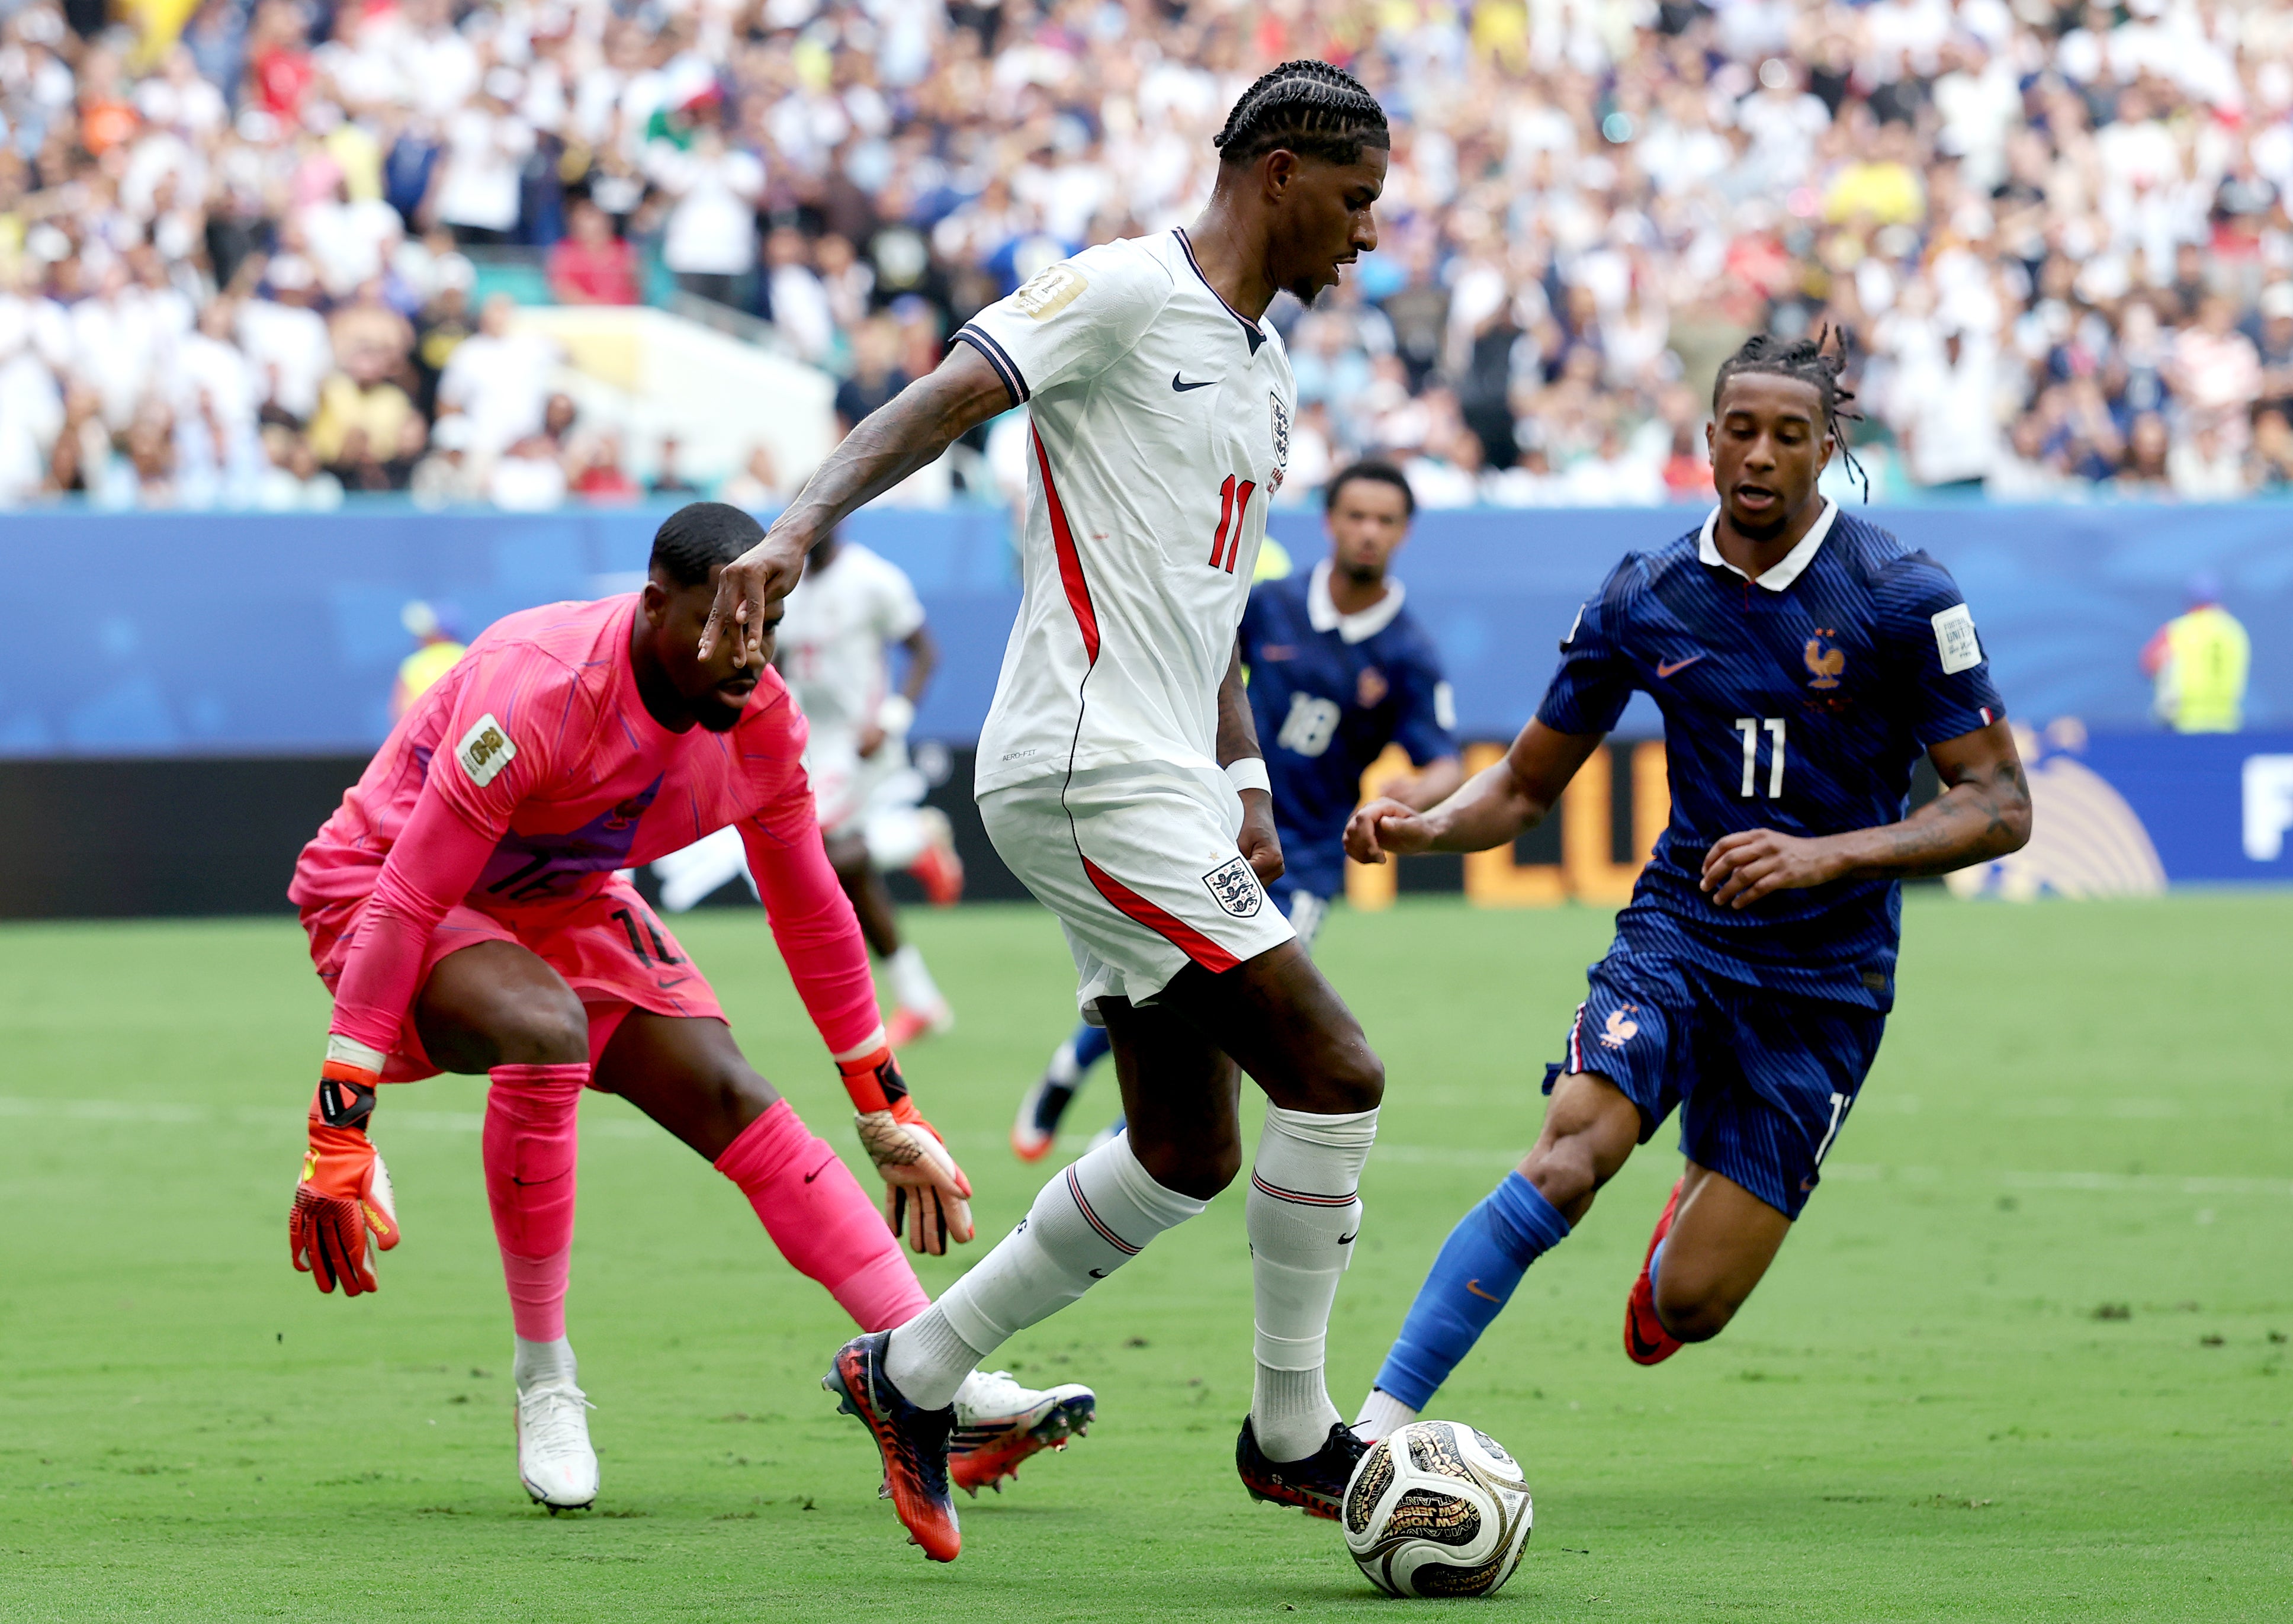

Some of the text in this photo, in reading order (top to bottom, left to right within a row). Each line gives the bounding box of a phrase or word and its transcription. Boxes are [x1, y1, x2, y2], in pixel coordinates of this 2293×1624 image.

[1209, 474, 1257, 575] 11
[1003, 749, 1038, 762] AERO-FIT
[1277, 691, 1341, 758] 18
[1735, 717, 1786, 798] 11
[1815, 1092, 1851, 1166] 1
[1362, 1450, 1392, 1523] ATLANTA
[1435, 1507, 1470, 1527] NEW
[1438, 1497, 1467, 1517] NEW
